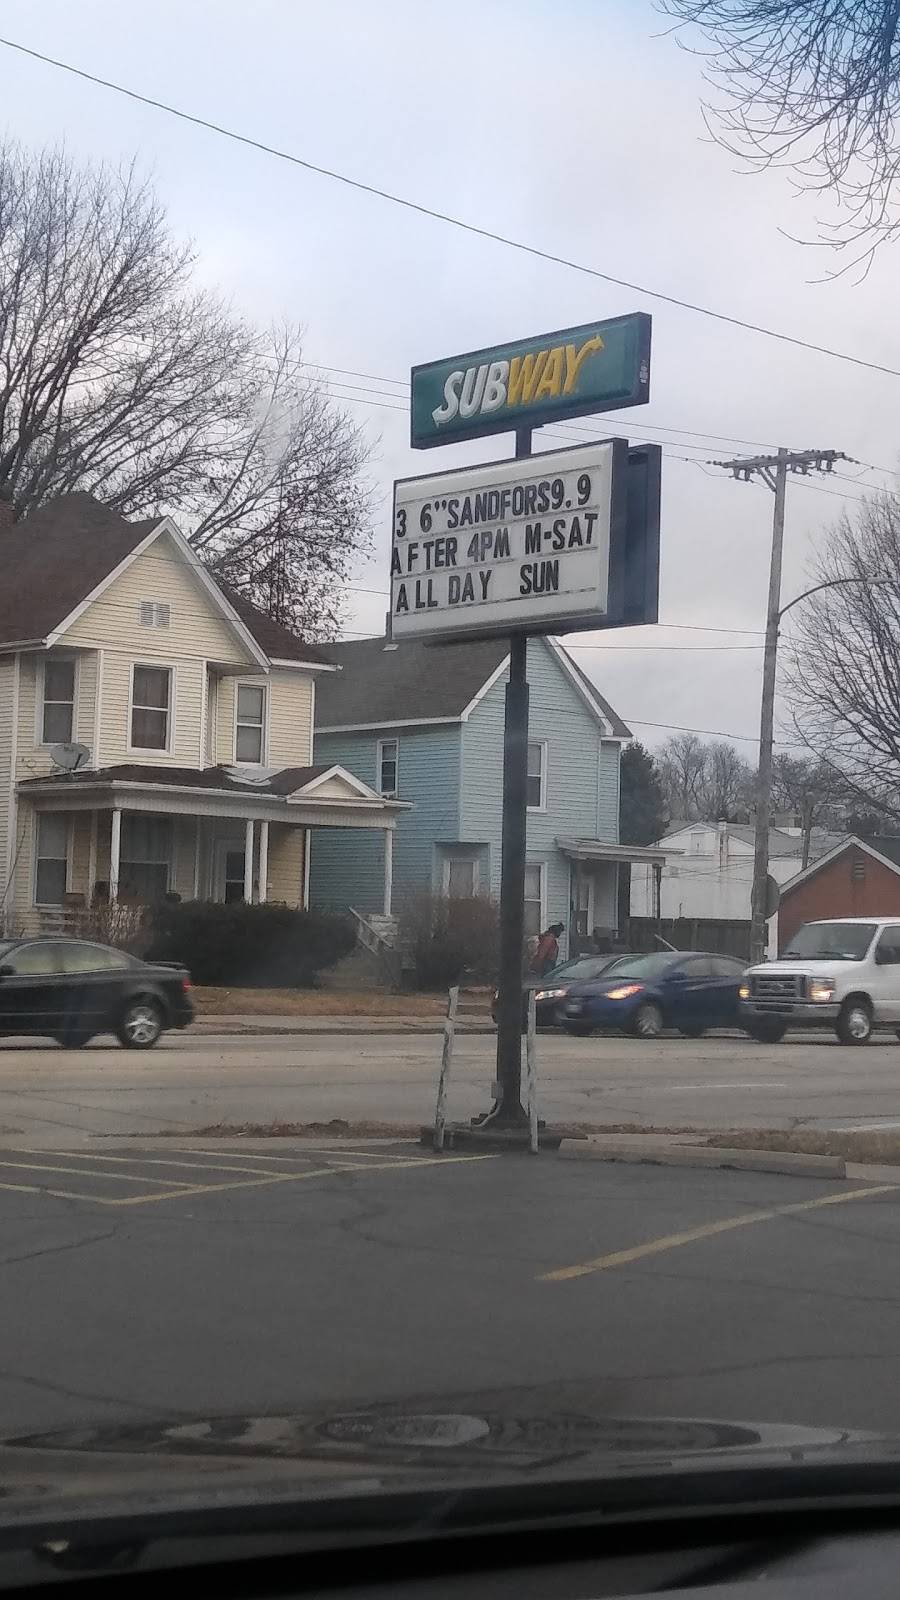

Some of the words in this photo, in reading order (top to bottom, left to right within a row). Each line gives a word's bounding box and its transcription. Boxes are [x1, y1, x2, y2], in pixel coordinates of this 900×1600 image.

[432, 334, 605, 428] SUBWAY
[389, 536, 458, 577] AFTER
[467, 527, 511, 563] 4PM
[525, 512, 599, 555] M-SAT
[396, 508, 407, 538] 3
[396, 578, 439, 613] ALL
[447, 569, 493, 605] DAY
[519, 559, 560, 595] SUN
